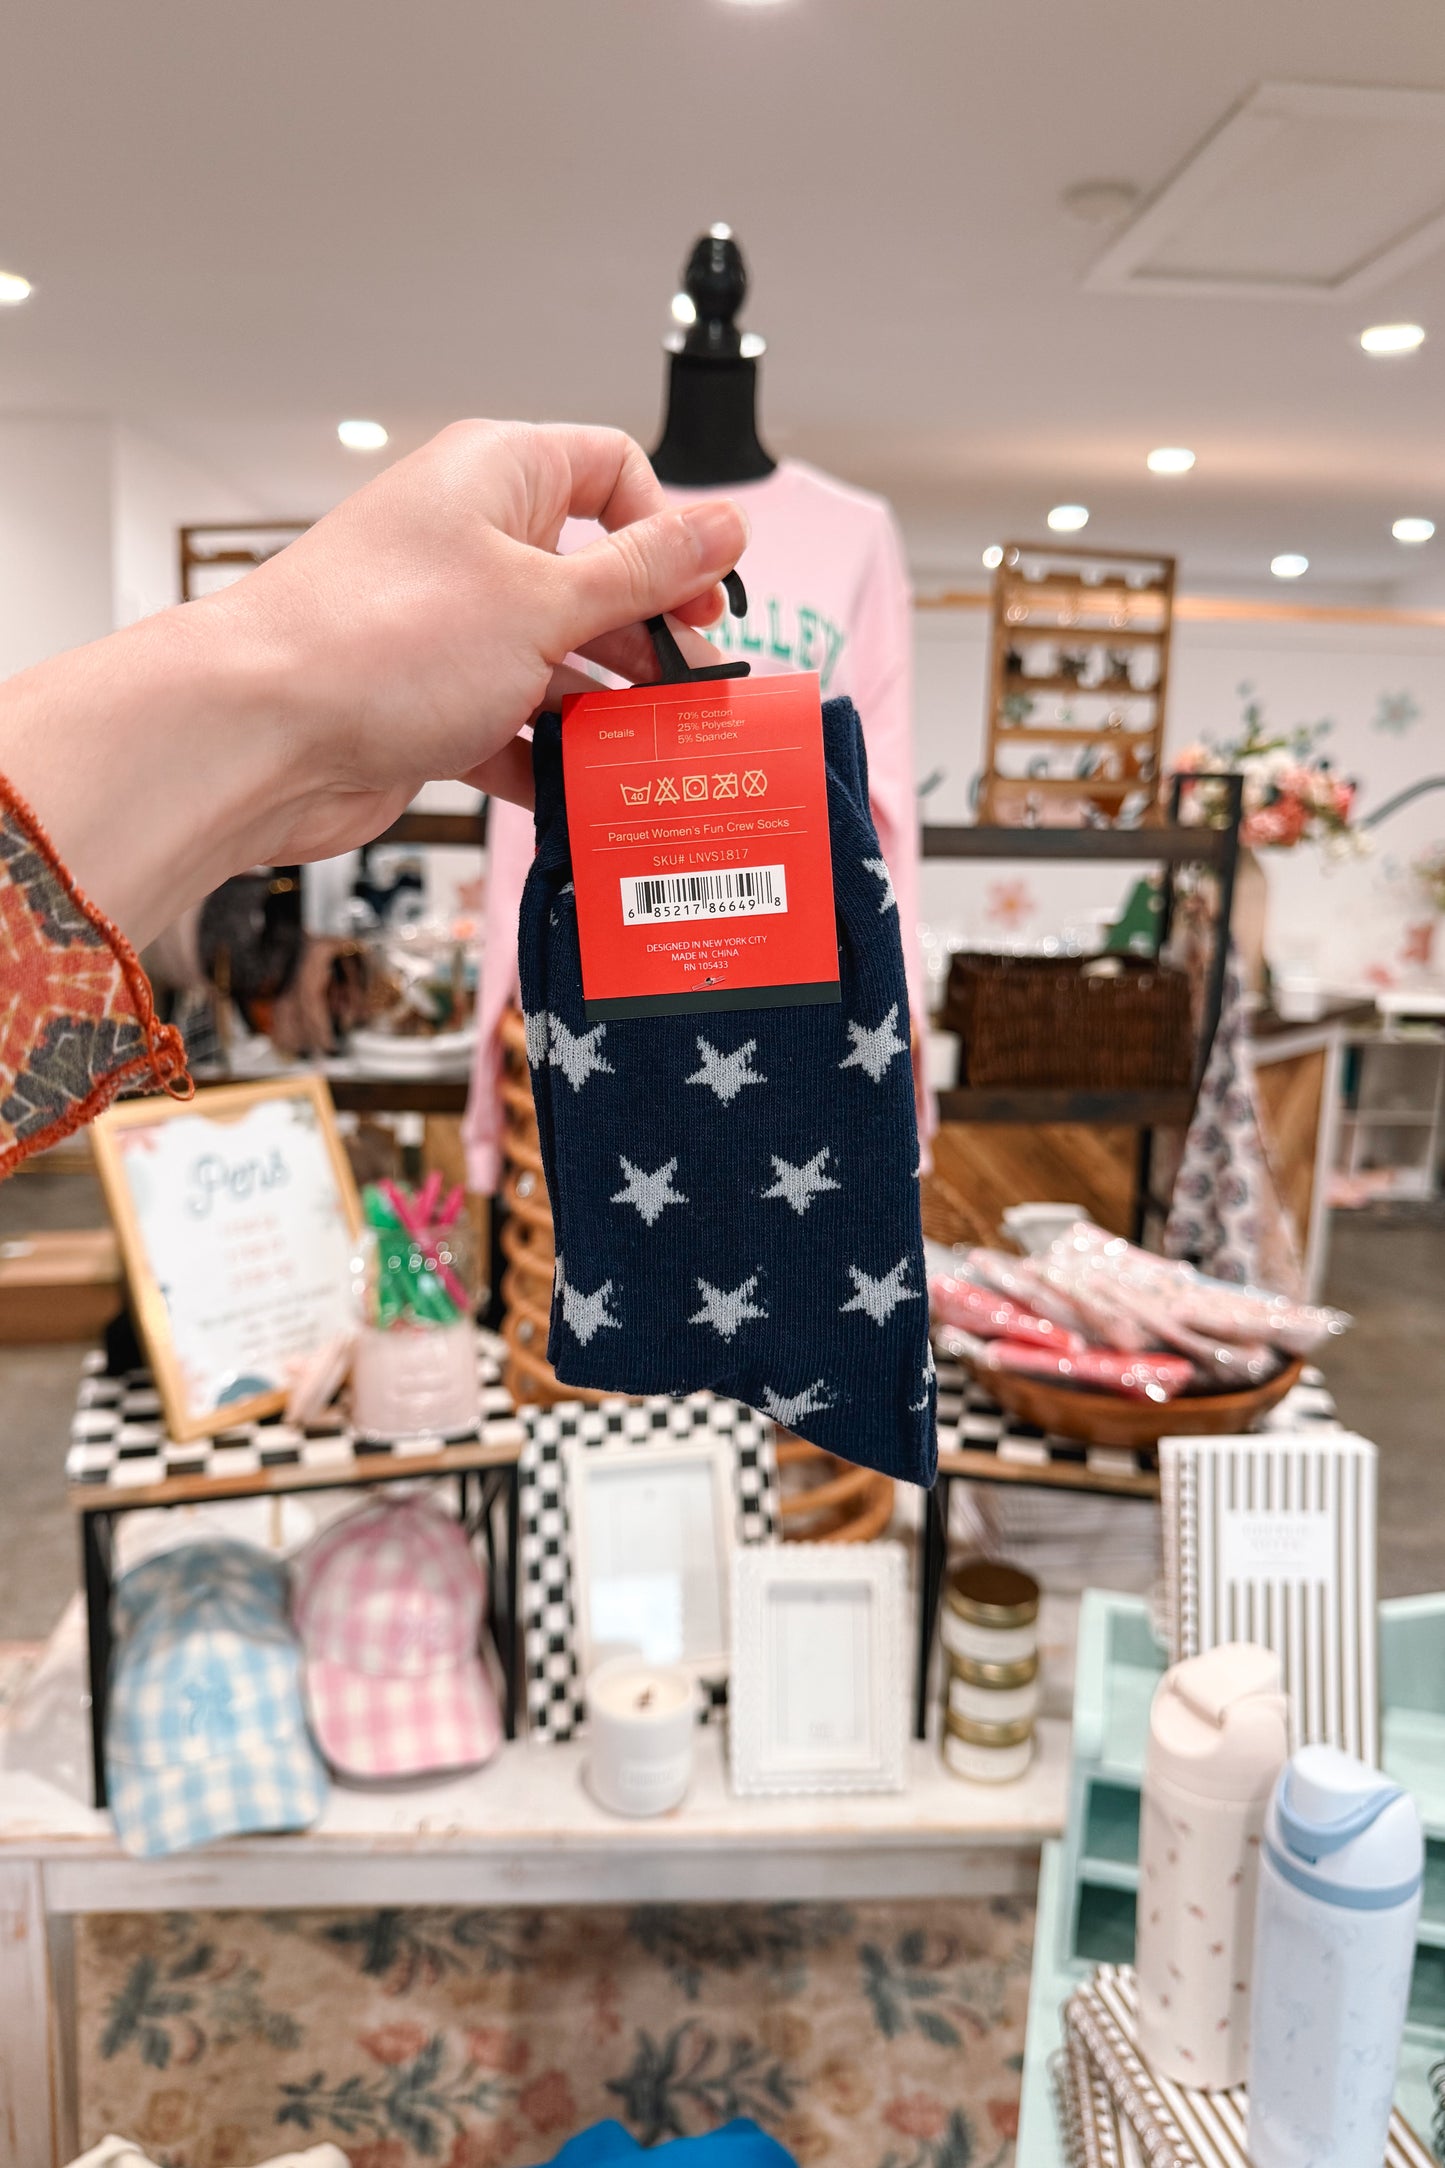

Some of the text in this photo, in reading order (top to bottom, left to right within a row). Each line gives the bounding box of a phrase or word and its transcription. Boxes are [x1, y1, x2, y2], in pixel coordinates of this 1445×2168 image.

[705, 598, 845, 690] LLEY
[677, 709, 733, 720] 70% Cotton
[677, 719, 746, 732] 25% Polyester
[599, 729, 635, 740] Details
[677, 731, 738, 744] 5% Spandex
[630, 792, 644, 801] 40
[608, 818, 790, 843] Parquet Women's Fun Crew Socks
[652, 848, 749, 867] SKU# LNVS1817
[646, 935, 768, 953] DESIGNED IN NEW YORK CITY
[671, 948, 739, 961] MADE IN CHINA
[683, 960, 729, 972] RN 105433
